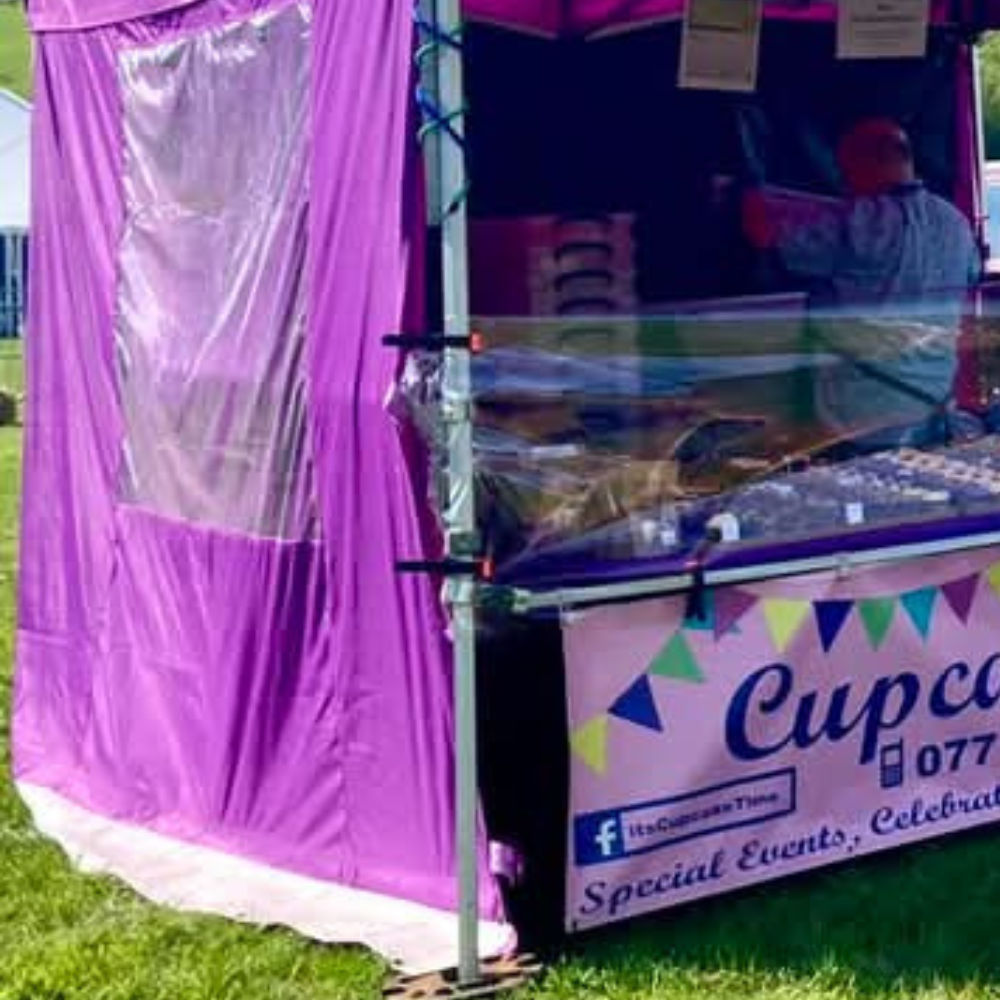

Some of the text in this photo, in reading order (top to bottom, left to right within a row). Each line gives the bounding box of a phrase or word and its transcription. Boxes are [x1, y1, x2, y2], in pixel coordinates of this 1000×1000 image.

[917, 733, 996, 777] 077
[580, 850, 724, 915] Special
[737, 824, 861, 872] Events,
